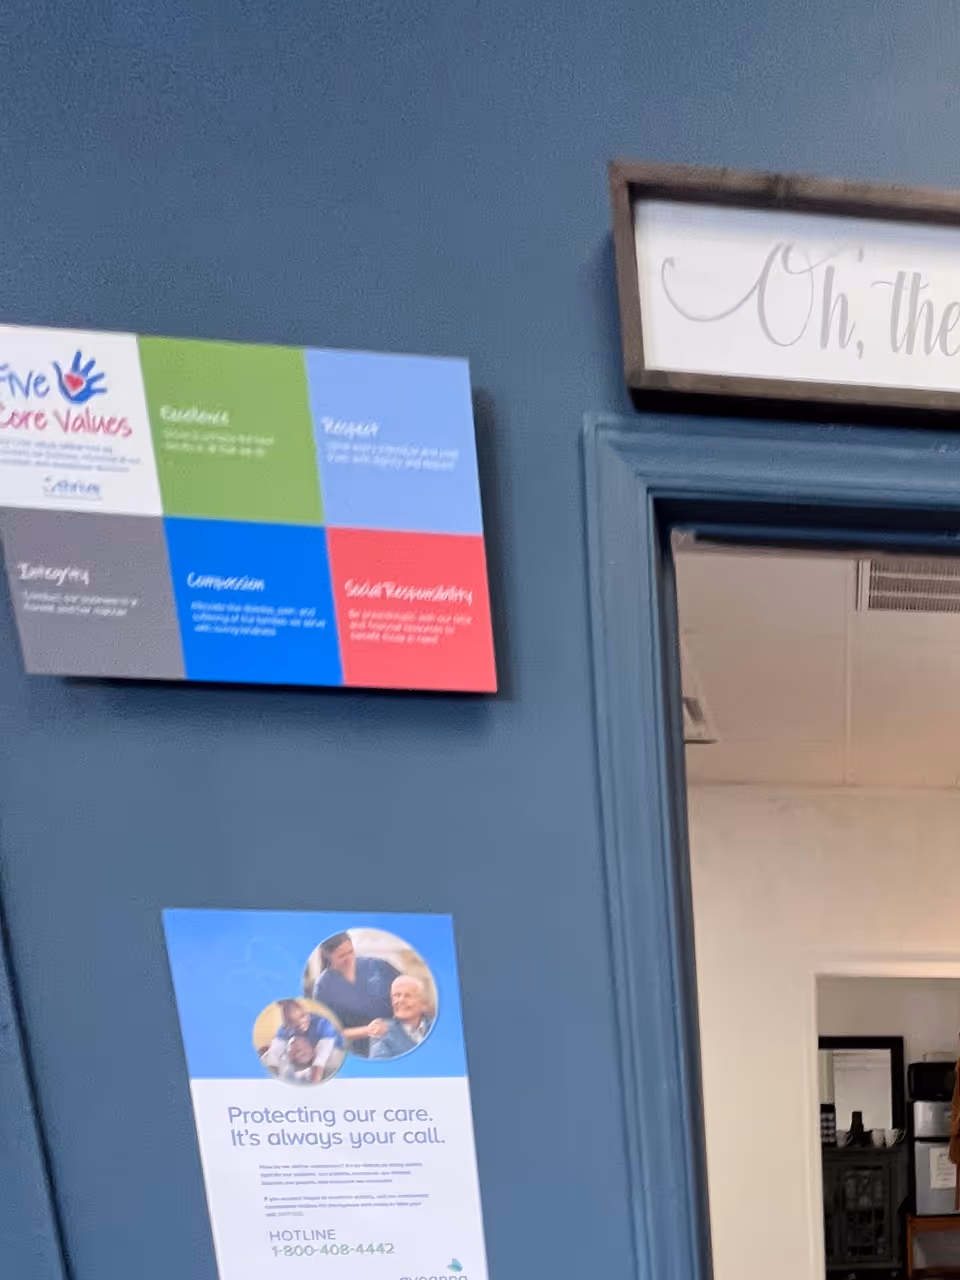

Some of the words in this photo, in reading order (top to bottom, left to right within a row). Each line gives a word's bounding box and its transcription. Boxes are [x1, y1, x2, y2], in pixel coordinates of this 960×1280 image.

[661, 241, 866, 361] Oh,
[53, 407, 133, 437] Values
[227, 1106, 336, 1127] Protecting
[343, 1108, 377, 1123] our
[383, 1108, 434, 1122] care.
[231, 1129, 261, 1146] It's
[267, 1128, 344, 1149] always
[349, 1130, 396, 1149] your
[402, 1127, 446, 1144] call.
[269, 1228, 337, 1243] HOTLINE
[271, 1242, 395, 1258] 1-800-408-4442
